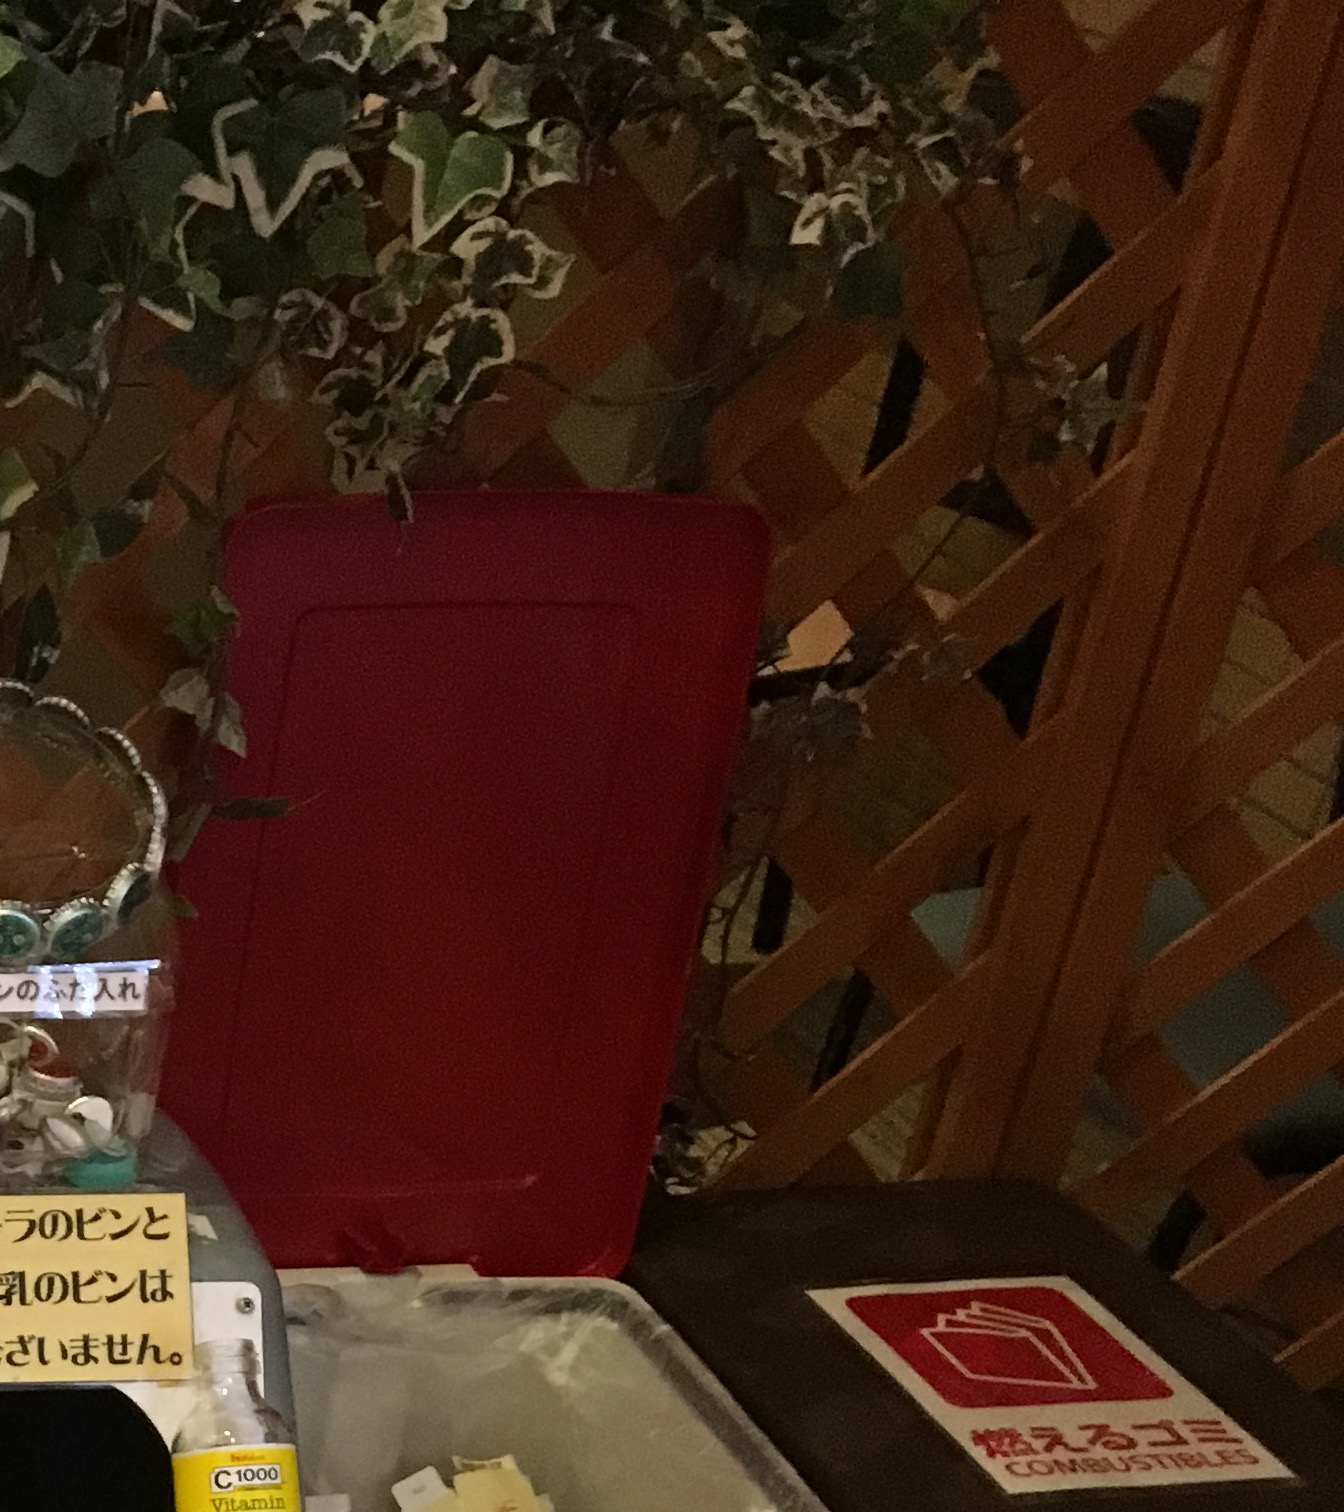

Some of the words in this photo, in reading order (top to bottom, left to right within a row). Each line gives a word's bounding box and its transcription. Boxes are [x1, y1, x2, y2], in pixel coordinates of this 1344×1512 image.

[970, 1417, 1244, 1459] 燃えるゴミ
[1005, 1446, 1260, 1478] COMBUSTIBLES
[210, 1496, 286, 1512] Vitamin
